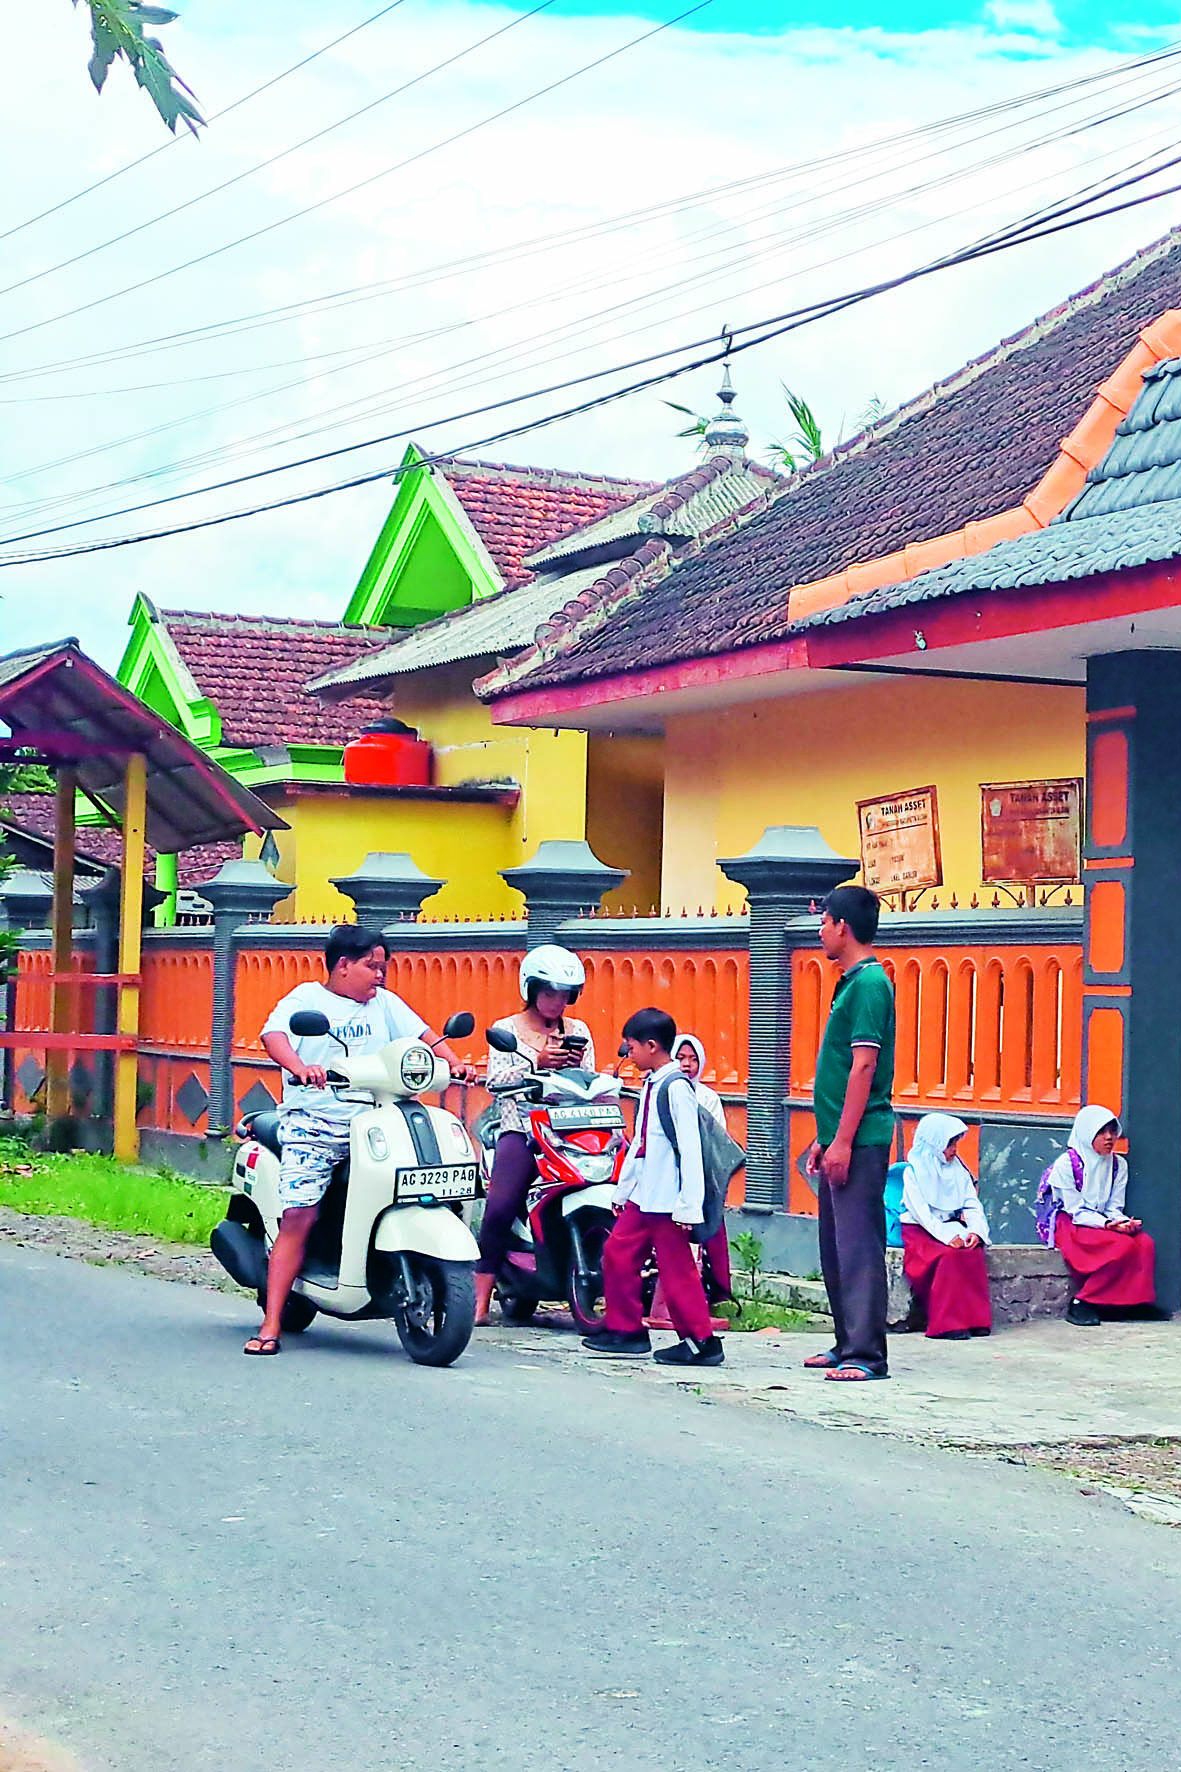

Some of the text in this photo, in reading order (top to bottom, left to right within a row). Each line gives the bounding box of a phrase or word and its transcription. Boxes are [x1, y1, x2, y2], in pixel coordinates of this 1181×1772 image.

[1042, 791, 1070, 802] ASSET
[881, 799, 926, 816] TANAH ASSET
[402, 1173, 416, 1186] AG
[420, 1170, 449, 1185] 3229
